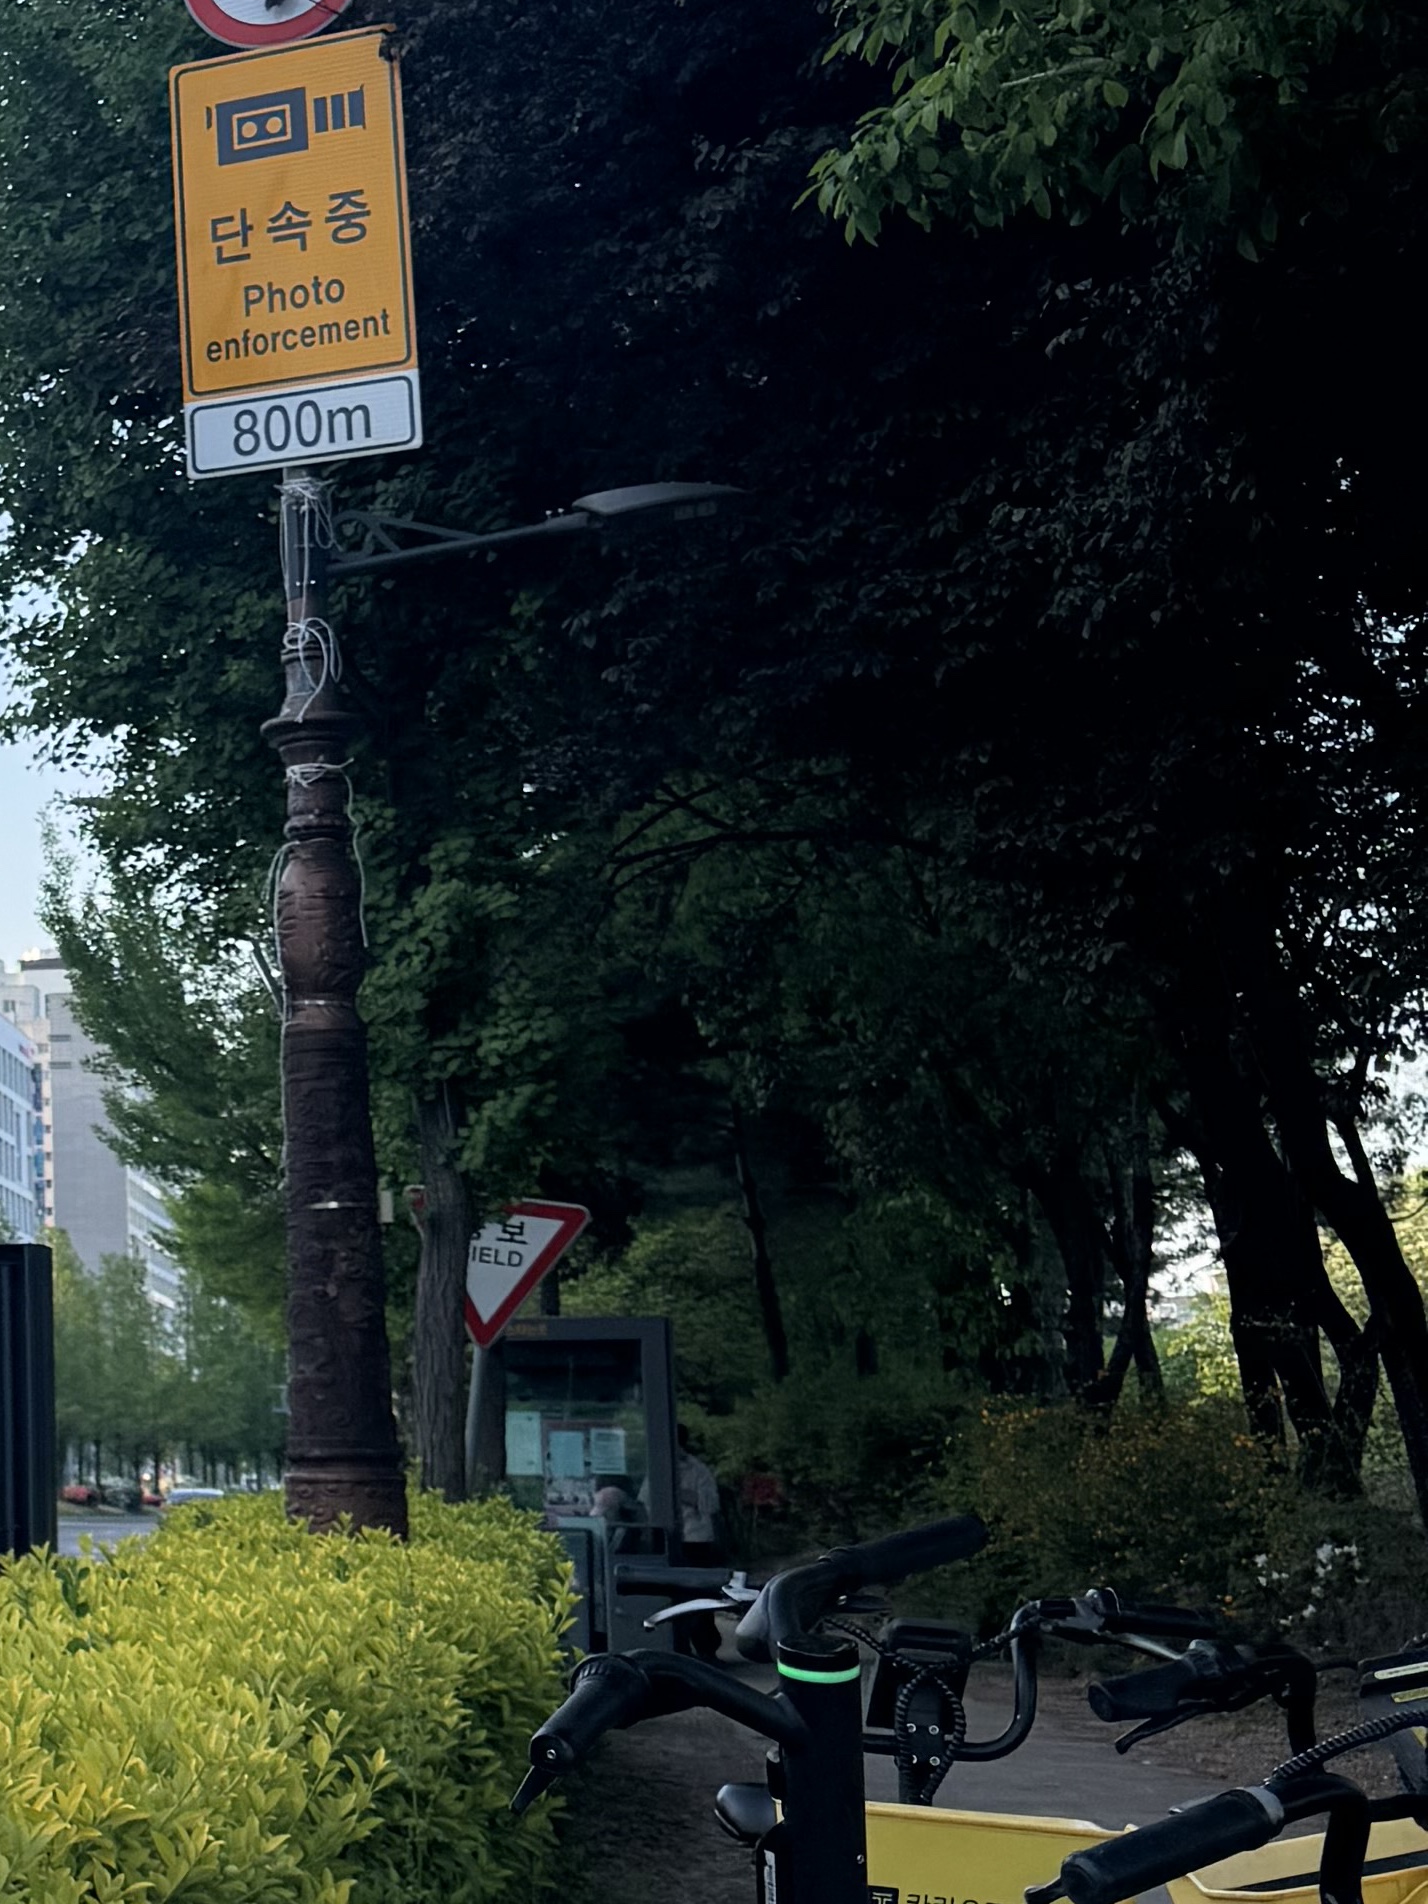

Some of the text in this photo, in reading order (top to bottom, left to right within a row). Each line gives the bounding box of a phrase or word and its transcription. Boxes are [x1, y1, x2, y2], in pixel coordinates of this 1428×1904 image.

[210, 188, 372, 266] 단속중
[243, 274, 346, 318] Photo
[205, 307, 391, 363] enforcement
[232, 398, 373, 458] 800m
[471, 1246, 524, 1268] IELD
